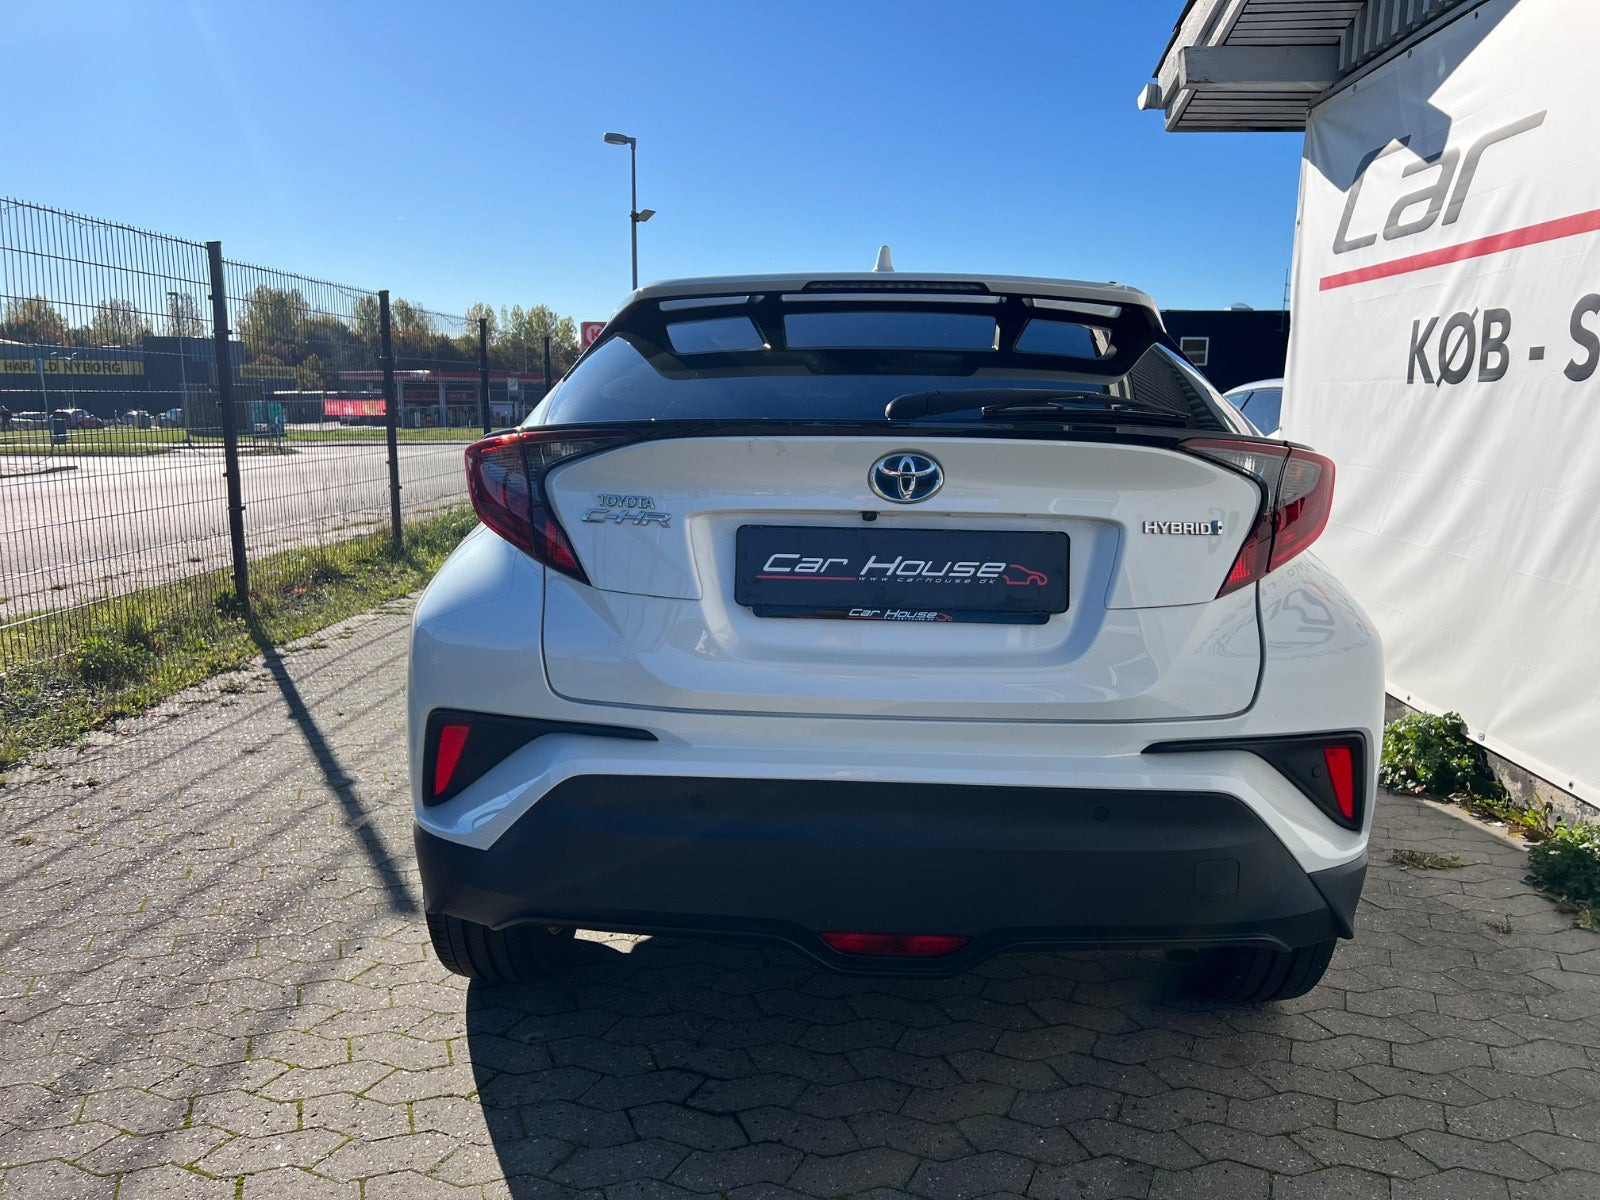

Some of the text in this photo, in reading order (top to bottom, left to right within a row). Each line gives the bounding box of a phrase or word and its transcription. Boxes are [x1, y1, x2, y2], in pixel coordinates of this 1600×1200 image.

[1333, 109, 1547, 254] Car
[1406, 306, 1512, 388] KØB
[63, 361, 121, 373] NYBORG
[598, 493, 656, 510] TOYOTA
[581, 508, 672, 528] C-HR
[1142, 521, 1213, 535] HYBRID
[762, 553, 1006, 578] Car House
[858, 576, 998, 585] www.carhouse.dk
[848, 608, 881, 617] Car
[884, 609, 938, 619] House
